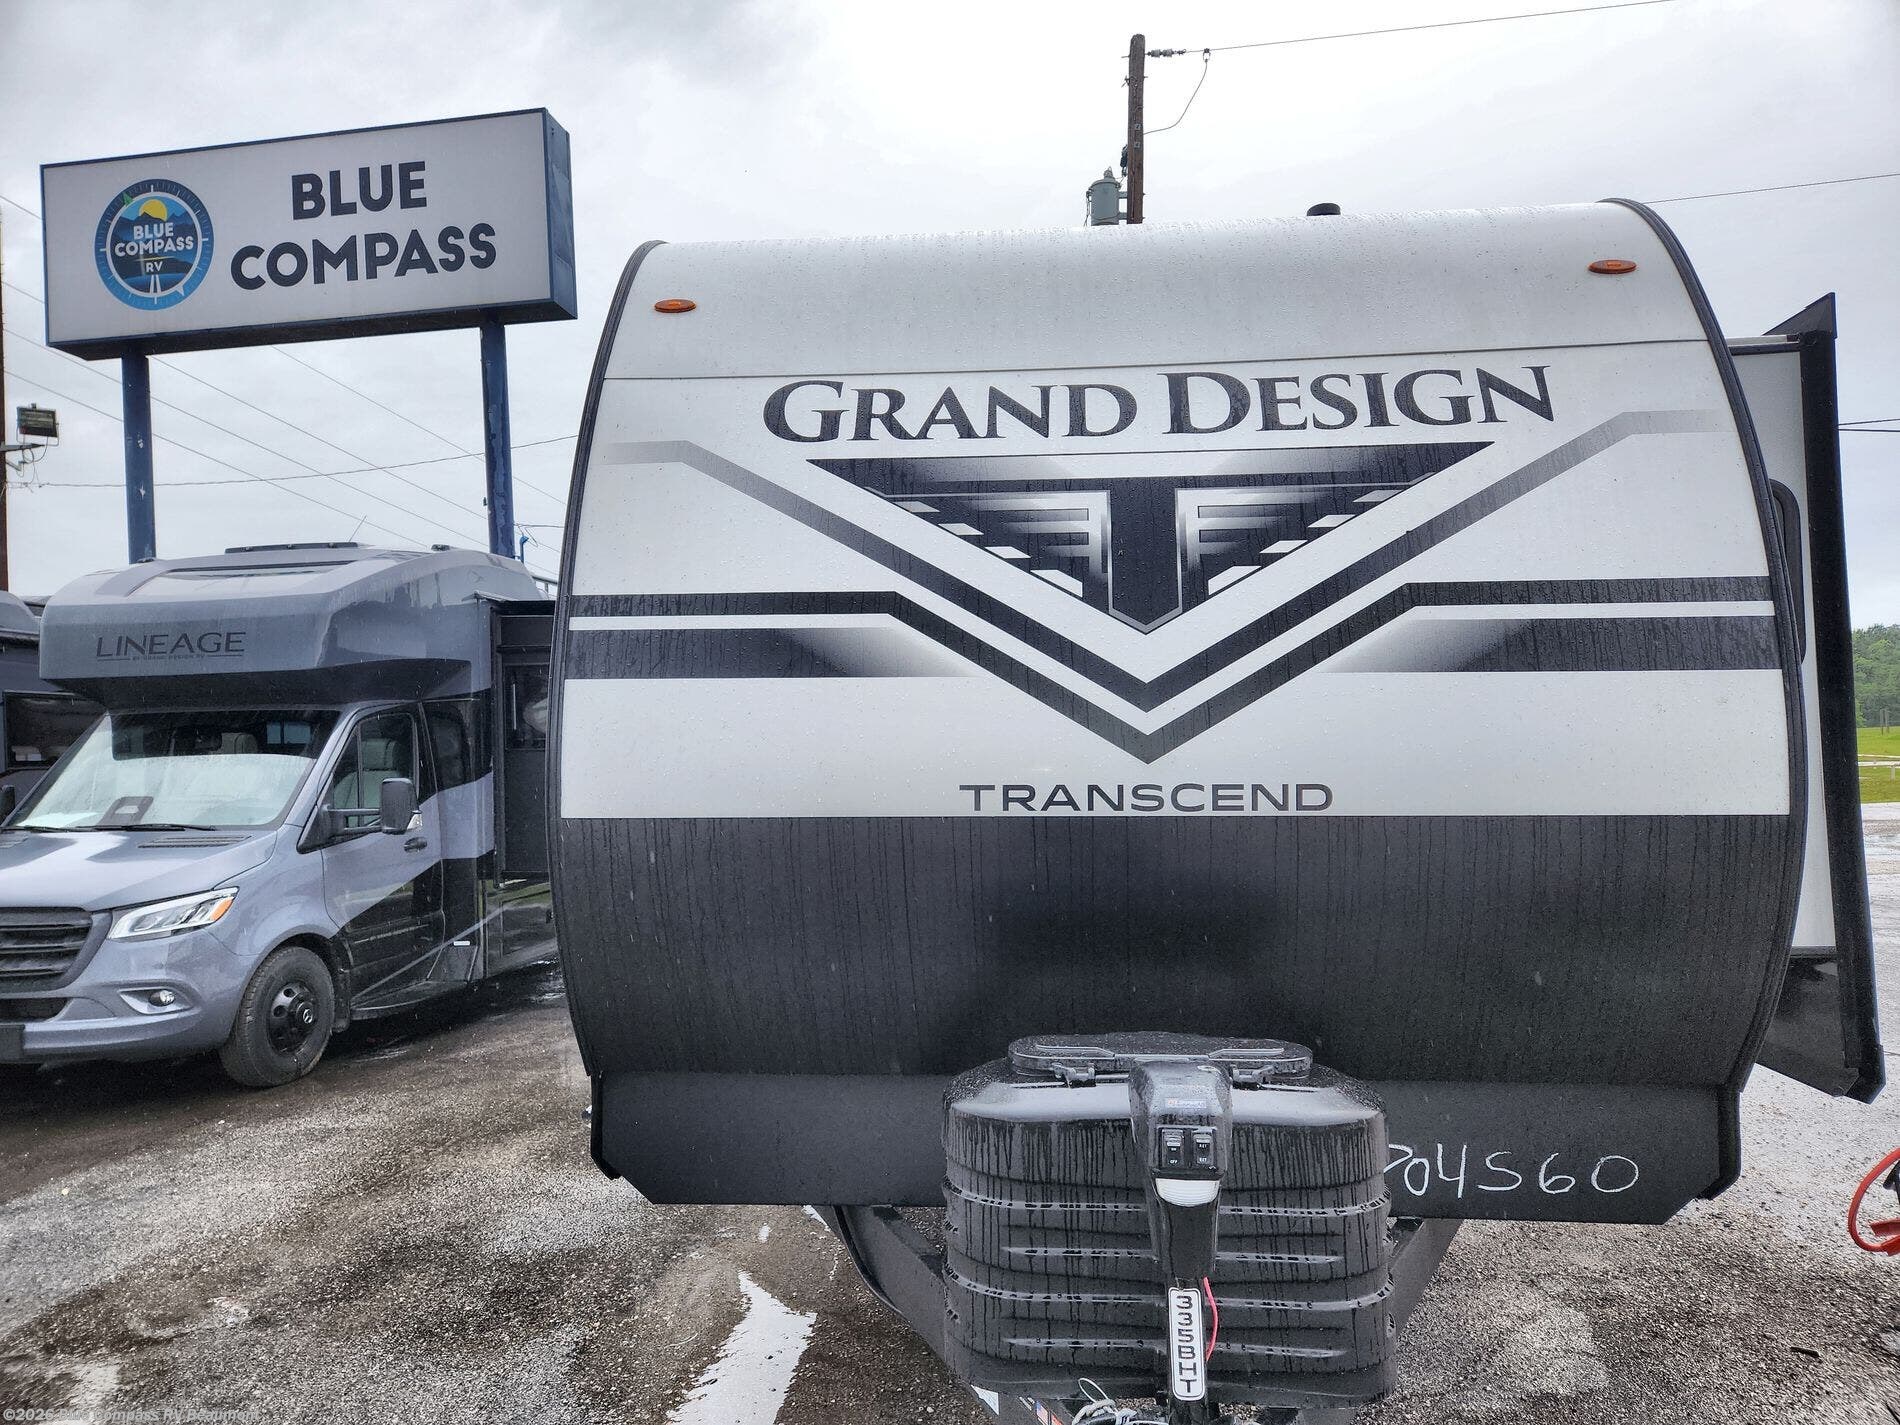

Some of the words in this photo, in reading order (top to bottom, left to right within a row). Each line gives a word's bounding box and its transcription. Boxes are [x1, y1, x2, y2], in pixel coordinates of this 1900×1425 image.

[291, 160, 427, 220] BLUE
[114, 235, 194, 257] COMPASS
[133, 222, 174, 240] BLUE
[145, 261, 163, 273] RV
[230, 222, 497, 291] COMPASS
[762, 379, 1138, 443] GRAND
[1156, 364, 1555, 436] DESIGN
[96, 631, 247, 657] LINEAGE
[958, 782, 1334, 813] TRANSCEND
[1176, 1295, 1197, 1393] 335BHT
